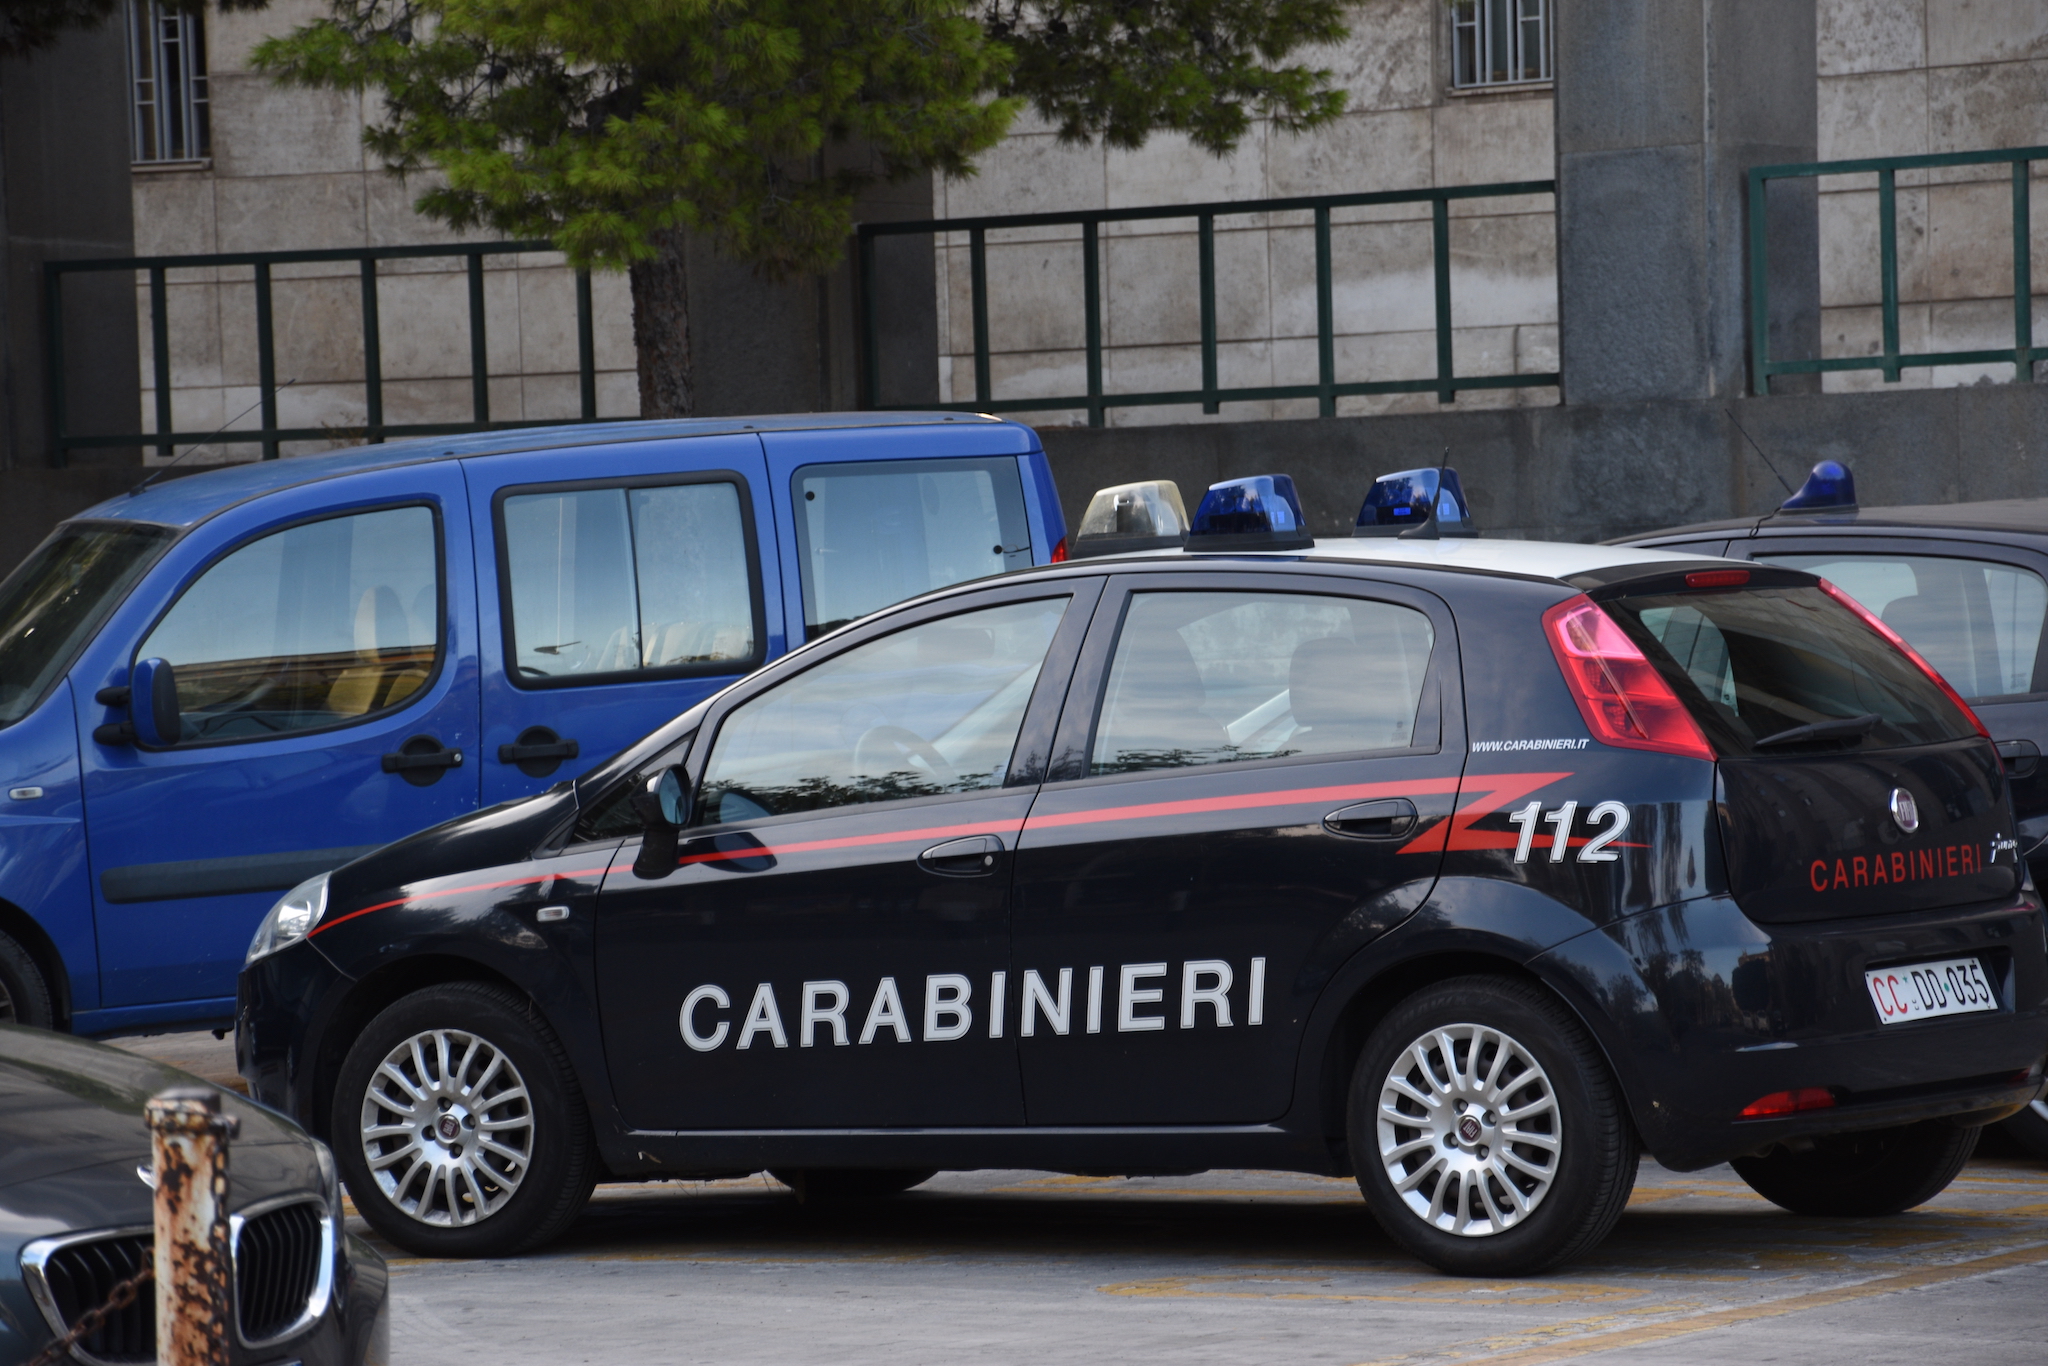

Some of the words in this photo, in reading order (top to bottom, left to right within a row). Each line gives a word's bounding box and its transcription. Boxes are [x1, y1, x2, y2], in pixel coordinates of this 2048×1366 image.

[1472, 738, 1590, 753] WWW.CARABINIERI.IT
[1508, 800, 1631, 864] 112
[1810, 843, 1982, 893] CARABINIERI
[679, 956, 1267, 1053] CARABINIERI
